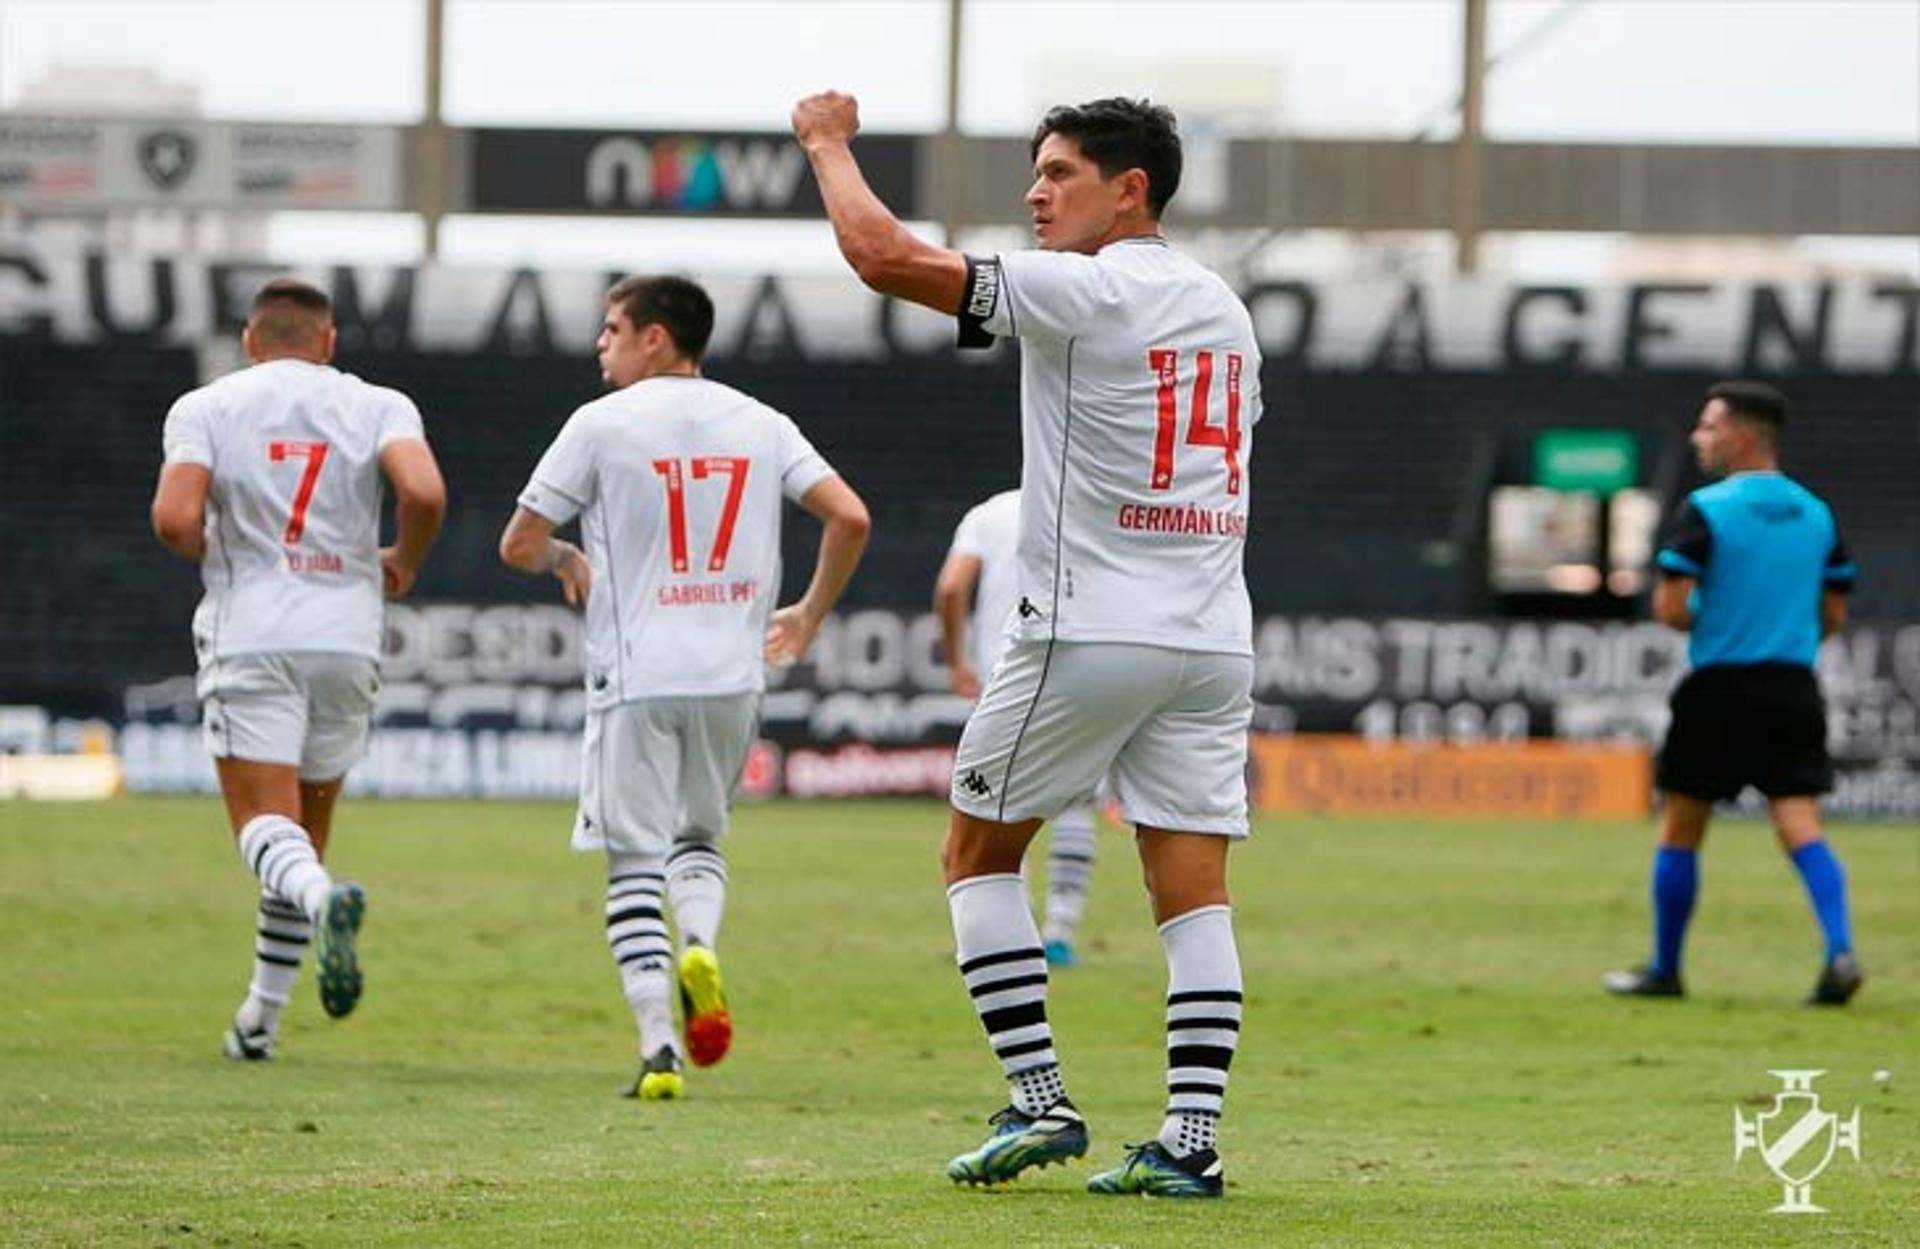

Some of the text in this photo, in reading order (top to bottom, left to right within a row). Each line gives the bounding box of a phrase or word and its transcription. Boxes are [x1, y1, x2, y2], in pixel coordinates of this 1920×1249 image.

[1149, 350, 1243, 494] 14
[269, 442, 329, 544] 7
[652, 458, 751, 573] 17
[1119, 502, 1212, 535] GERMÁN
[658, 584, 726, 606] GABRIEL
